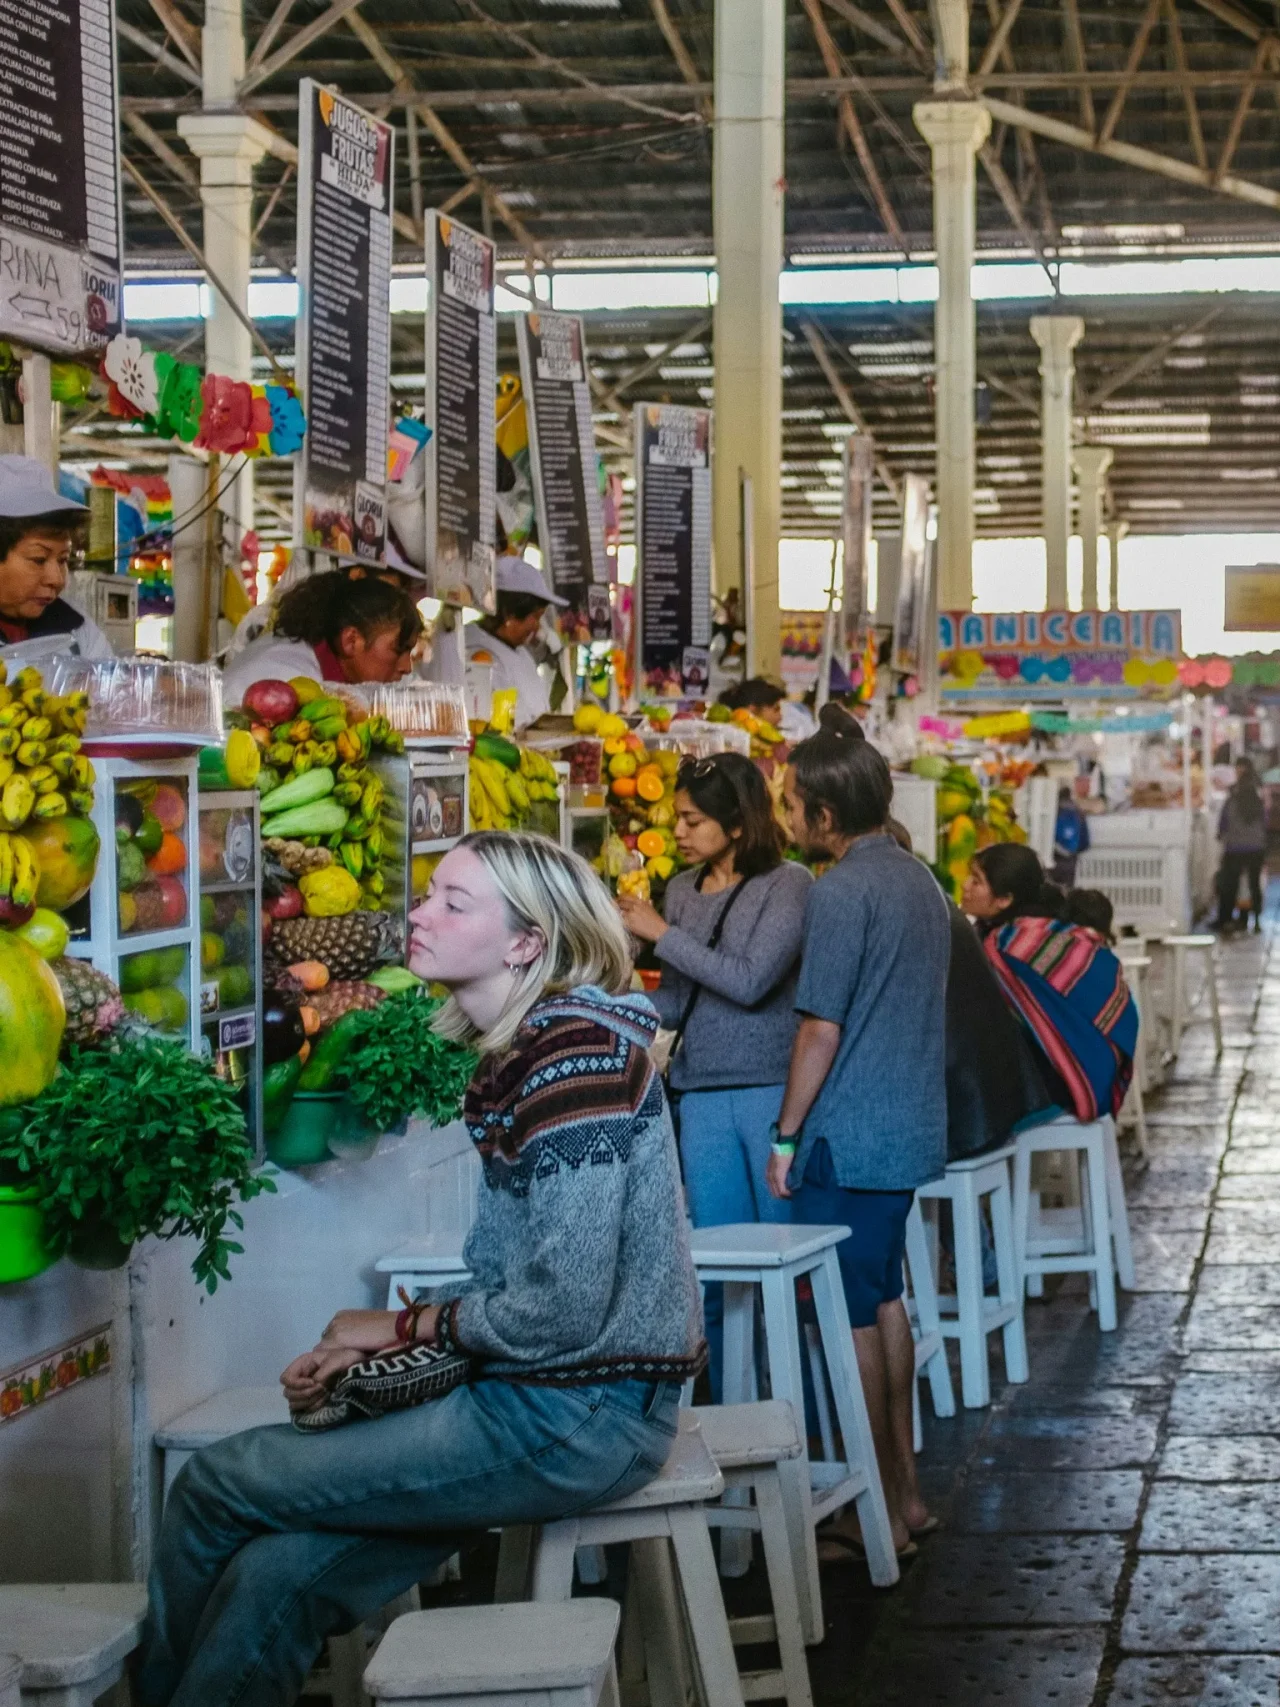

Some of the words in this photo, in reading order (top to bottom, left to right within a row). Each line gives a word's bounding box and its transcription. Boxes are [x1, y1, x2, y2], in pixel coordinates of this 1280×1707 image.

[19, 7, 32, 20] CON
[32, 13, 50, 29] LECHE
[15, 19, 29, 32] CON
[29, 25, 47, 41] LECHE
[19, 48, 32, 63] CON
[32, 55, 50, 70] LECHE
[23, 64, 36, 77] CON
[36, 70, 54, 86] LECHE
[25, 78, 38, 93] CON
[38, 86, 56, 101] LECHE
[30, 107, 38, 120] DE
[38, 111, 53, 126] PIÑA
[330, 100, 369, 143] JUGOS
[31, 123, 39, 135] DE
[39, 127, 62, 144] FRUTAS
[0, 154, 22, 171] PEPINO
[23, 162, 36, 177] CON
[331, 132, 375, 179] FRUTAS
[1, 168, 26, 185] POMELO
[1, 182, 26, 200] PONCHE
[26, 191, 35, 203] DE
[35, 194, 62, 212] CERVEZA
[1, 198, 22, 213] MEDIO
[22, 203, 49, 221] ESPECIAL
[31, 220, 43, 233] CON
[43, 225, 63, 241] MALTA
[82, 270, 116, 307] LORIA
[57, 306, 81, 346] 59
